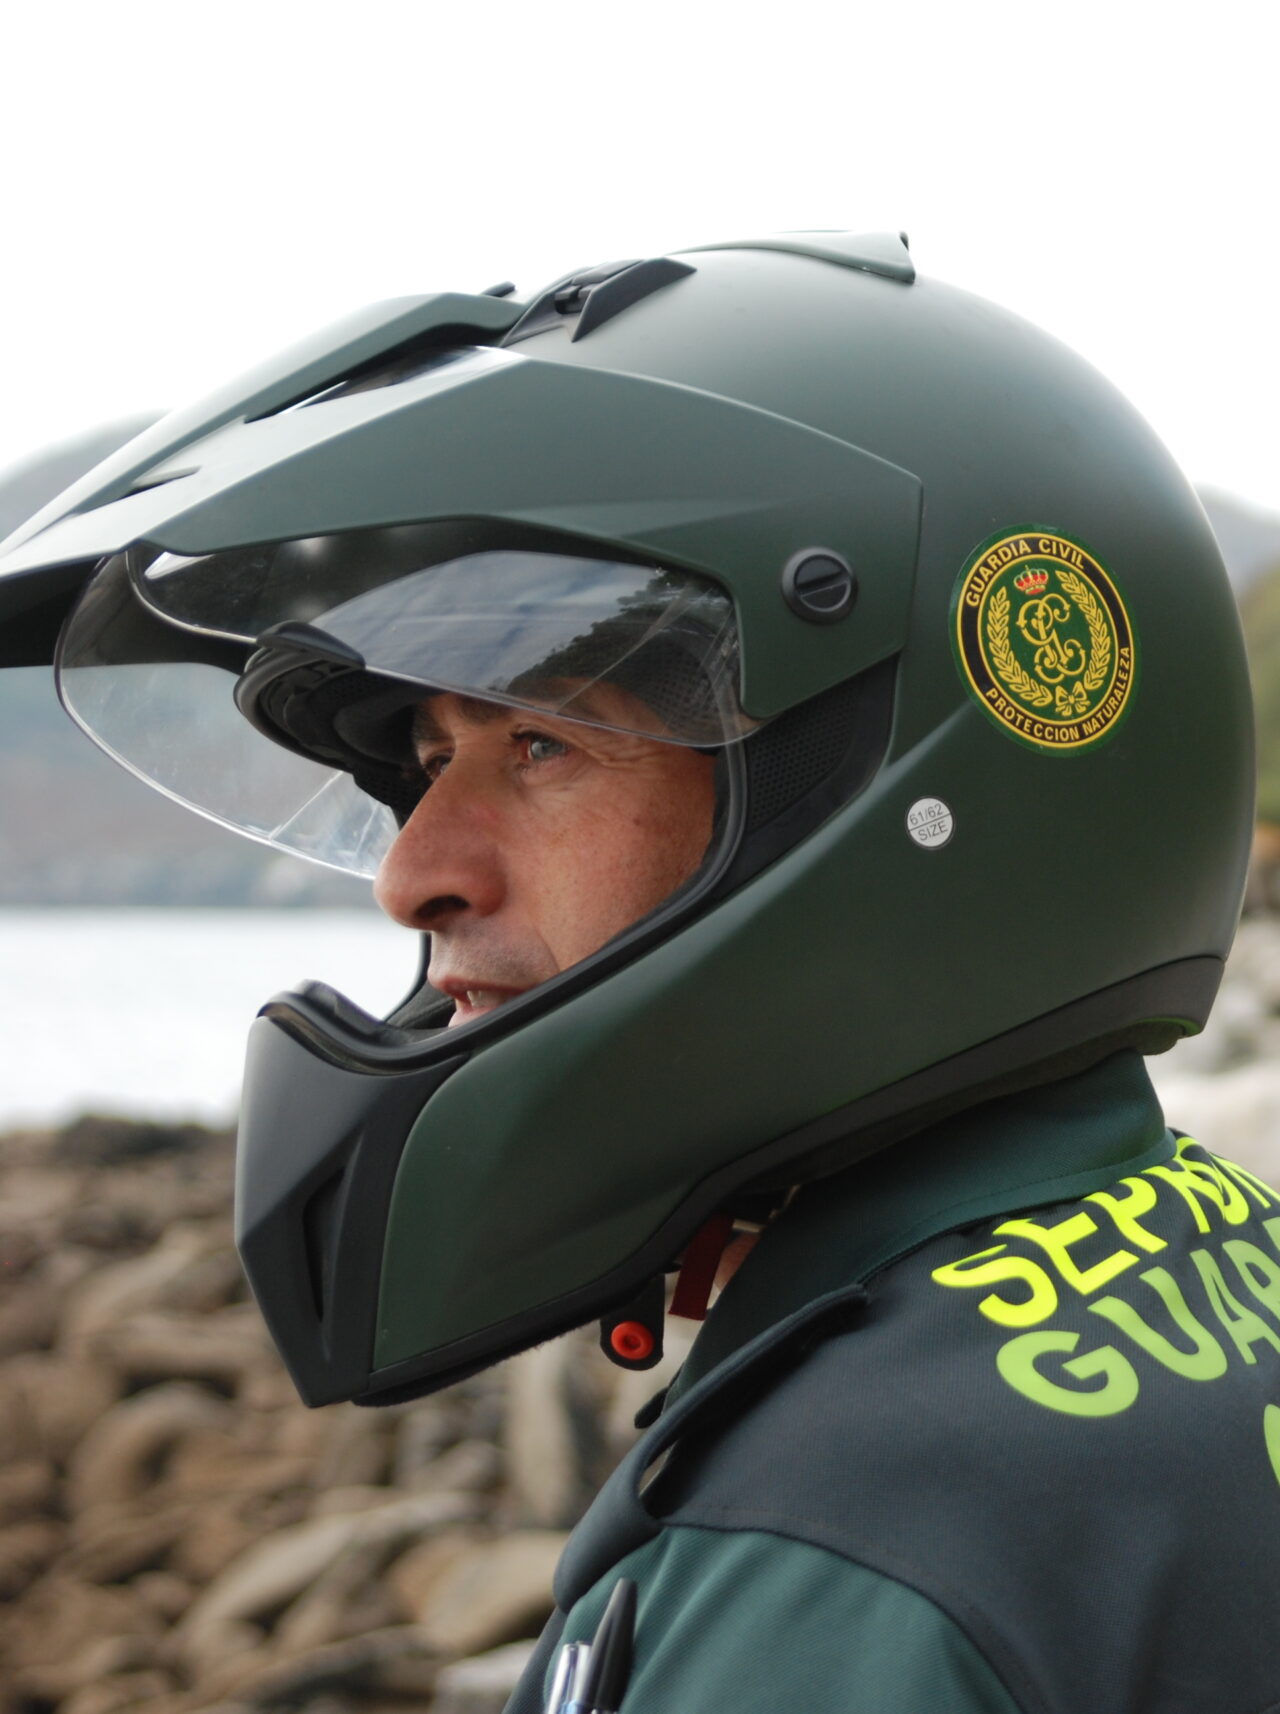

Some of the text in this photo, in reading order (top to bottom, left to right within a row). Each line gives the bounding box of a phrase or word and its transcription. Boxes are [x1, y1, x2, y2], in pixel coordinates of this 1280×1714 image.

[965, 538, 1085, 607] GUARDIA CIVIL
[985, 647, 1130, 741] PROTECCION NATURALEZA
[918, 820, 948, 841] SIZE
